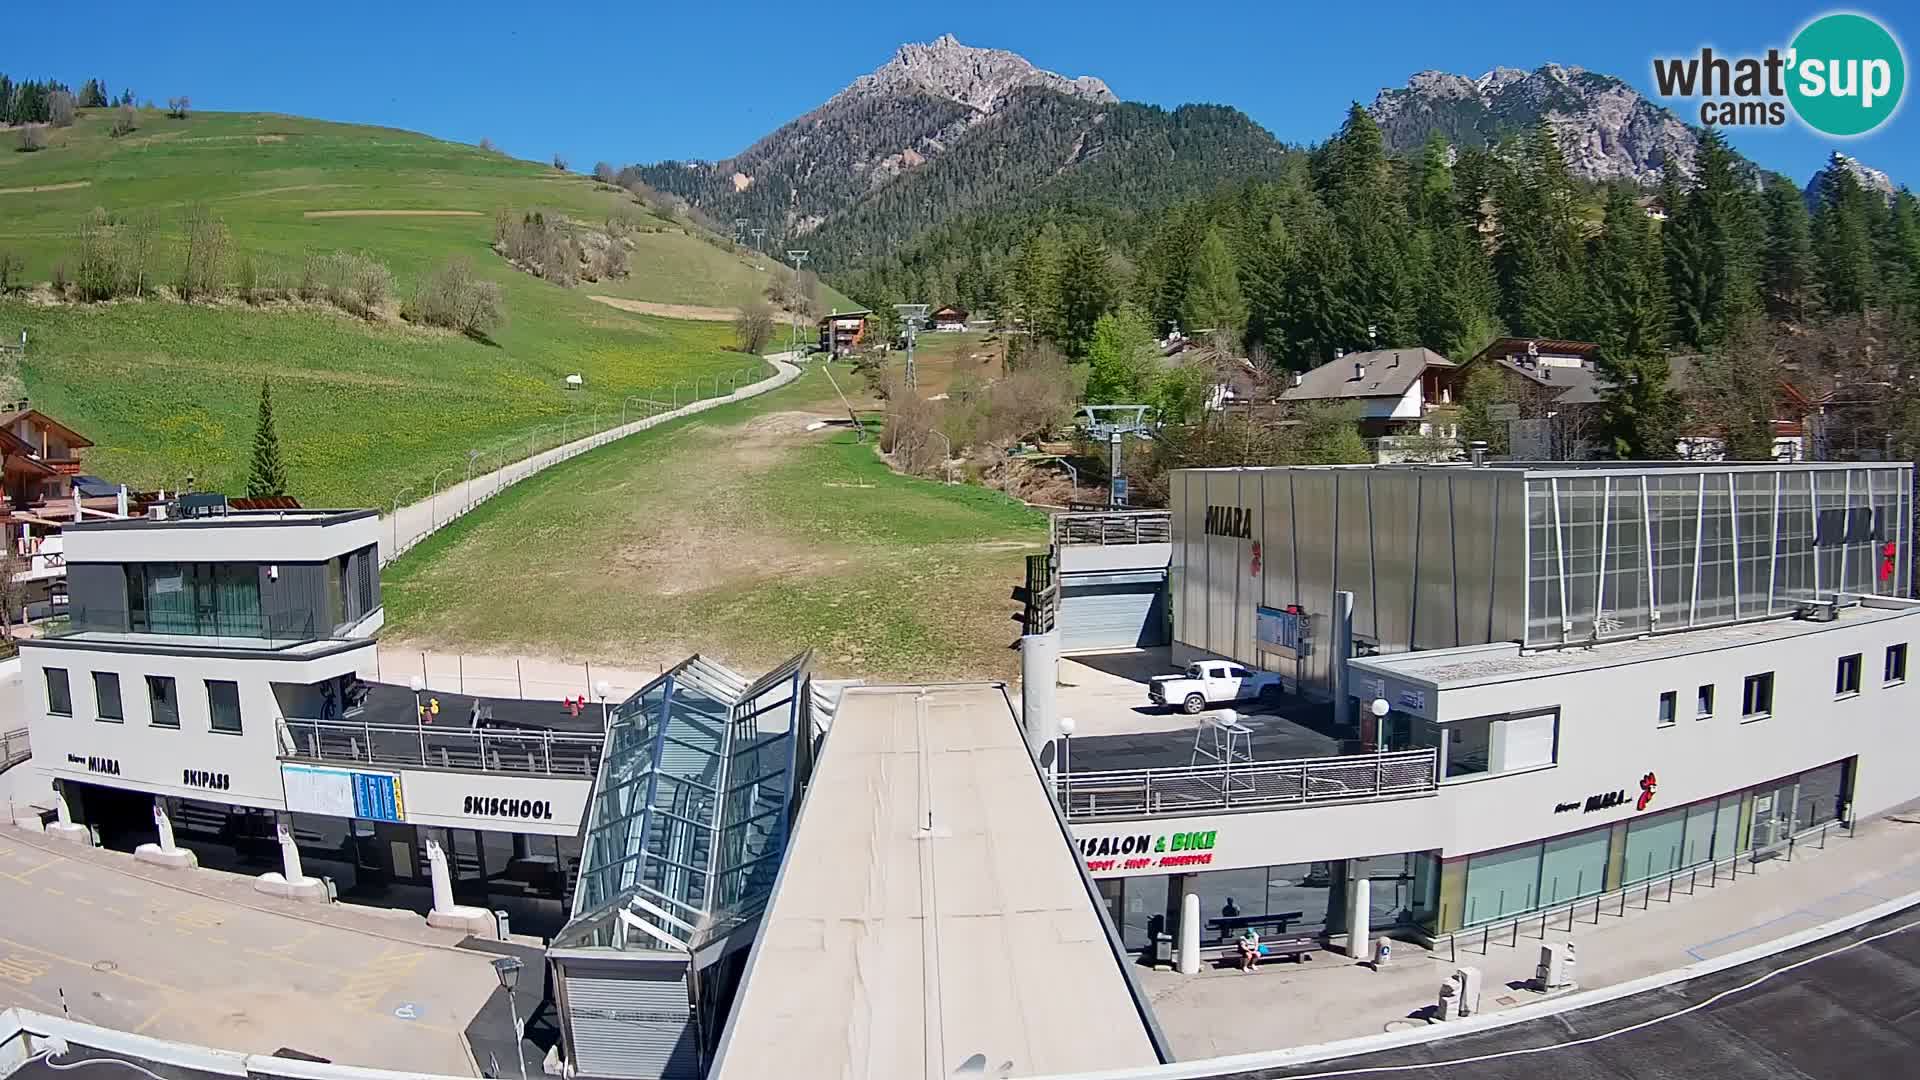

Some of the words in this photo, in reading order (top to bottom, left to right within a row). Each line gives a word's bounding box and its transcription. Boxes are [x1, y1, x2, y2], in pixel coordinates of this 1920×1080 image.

[1205, 505, 1252, 539] MIARA
[88, 756, 121, 776] MIARA
[183, 769, 230, 790] SKIPASS
[464, 796, 553, 820] SKISCHOOL
[1075, 834, 1152, 857] ISALON
[1154, 836, 1167, 853] &
[1171, 830, 1218, 852] BIKE
[1124, 858, 1152, 870] SHOP
